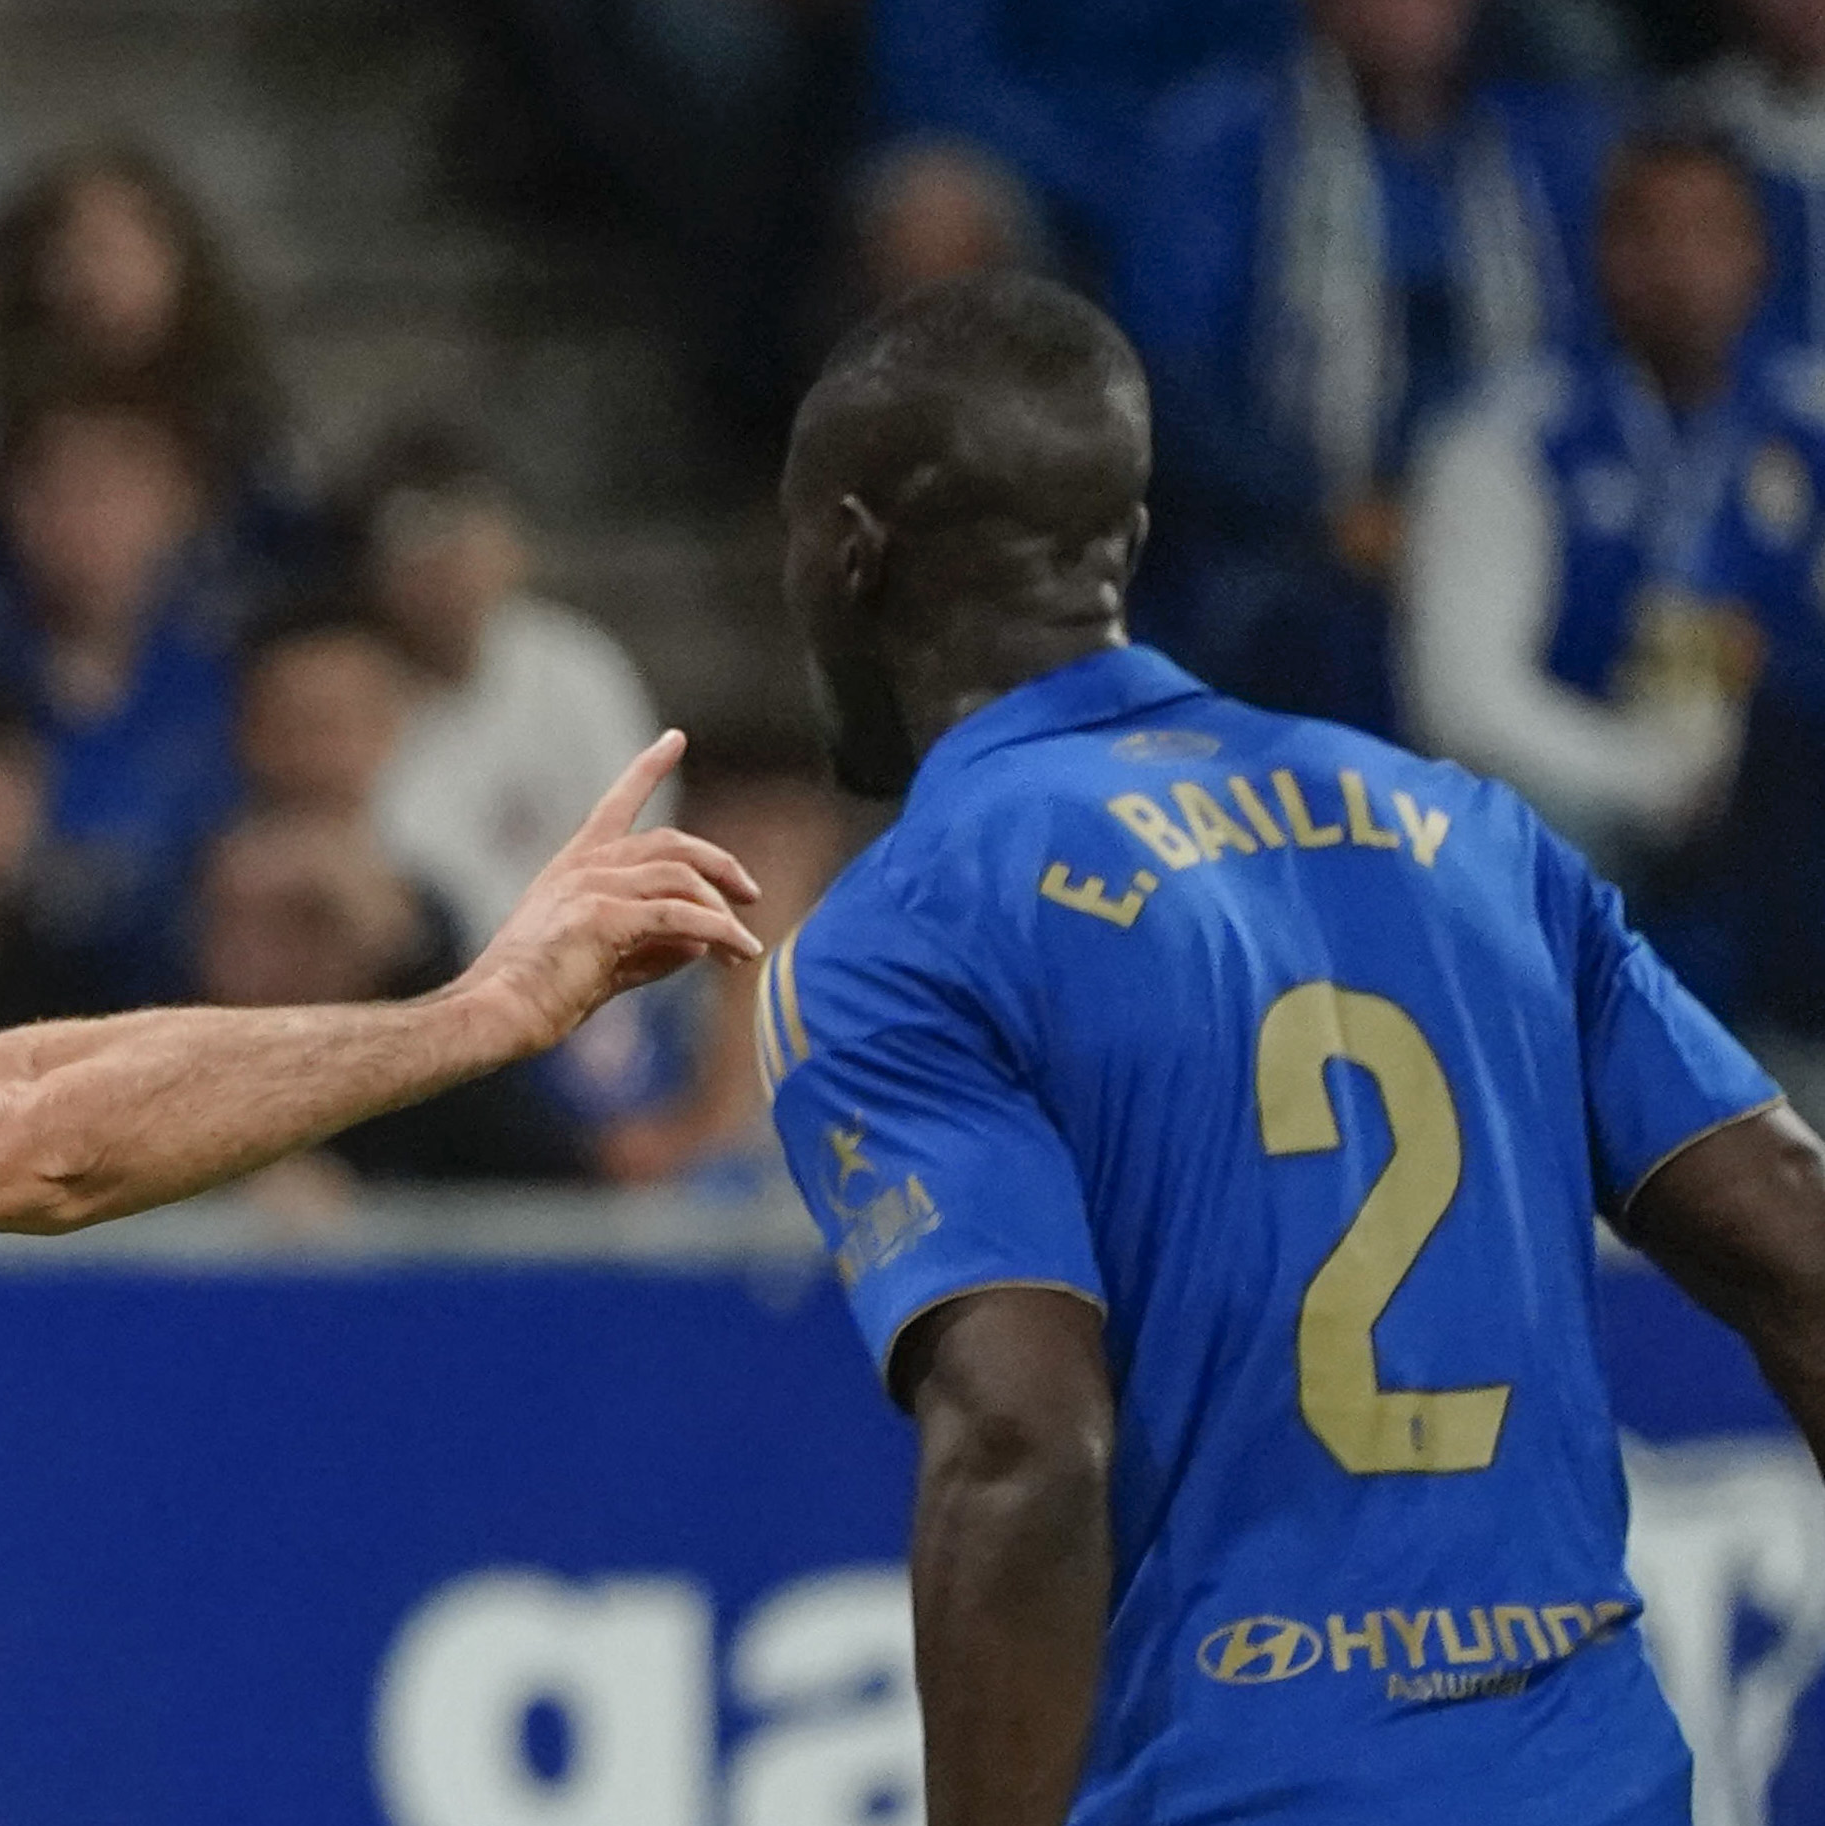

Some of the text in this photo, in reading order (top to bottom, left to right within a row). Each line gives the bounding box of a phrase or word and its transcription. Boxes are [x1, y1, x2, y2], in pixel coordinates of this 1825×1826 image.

[1040, 769, 1450, 928] E. BAILLY
[1254, 981, 1512, 1475] 2
